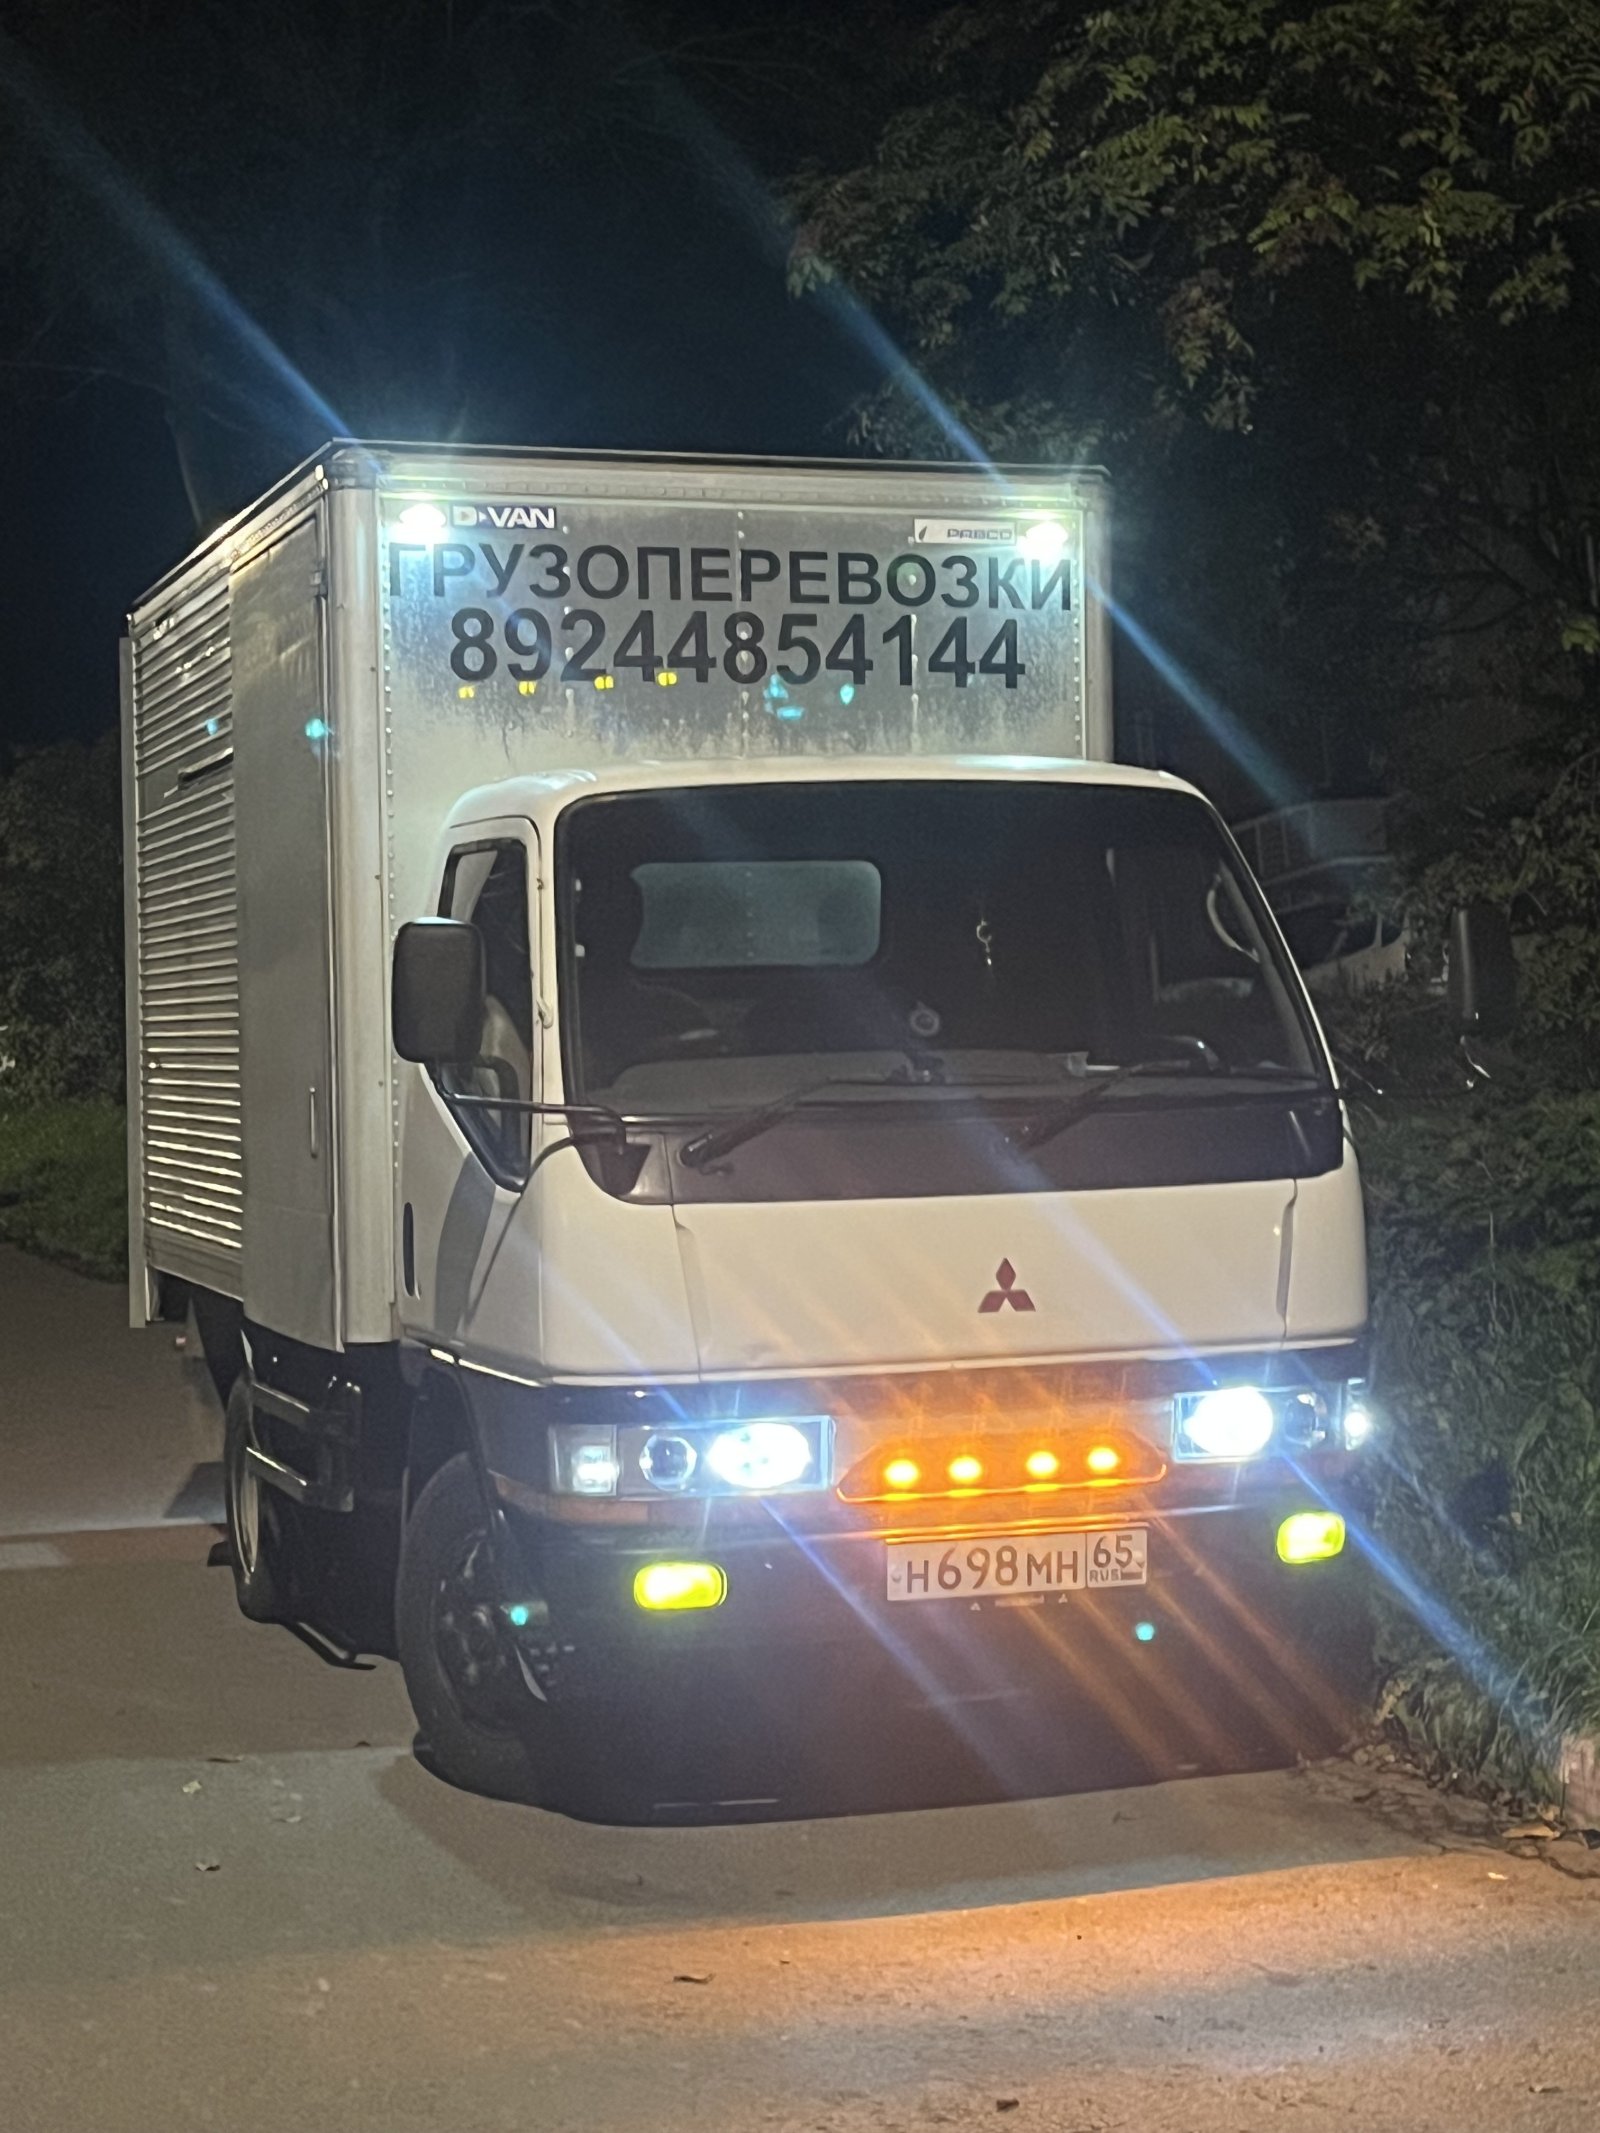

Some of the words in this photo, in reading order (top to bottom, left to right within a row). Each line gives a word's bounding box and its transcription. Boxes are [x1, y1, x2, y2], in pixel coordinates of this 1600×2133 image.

[389, 542, 1072, 611] ГРУЗОПЕРЕВОЗКИ
[449, 607, 1026, 689] 89244854144
[906, 1545, 1078, 1594] Н698МН
[1093, 1534, 1133, 1569] 65
[1089, 1568, 1119, 1582] RUS
